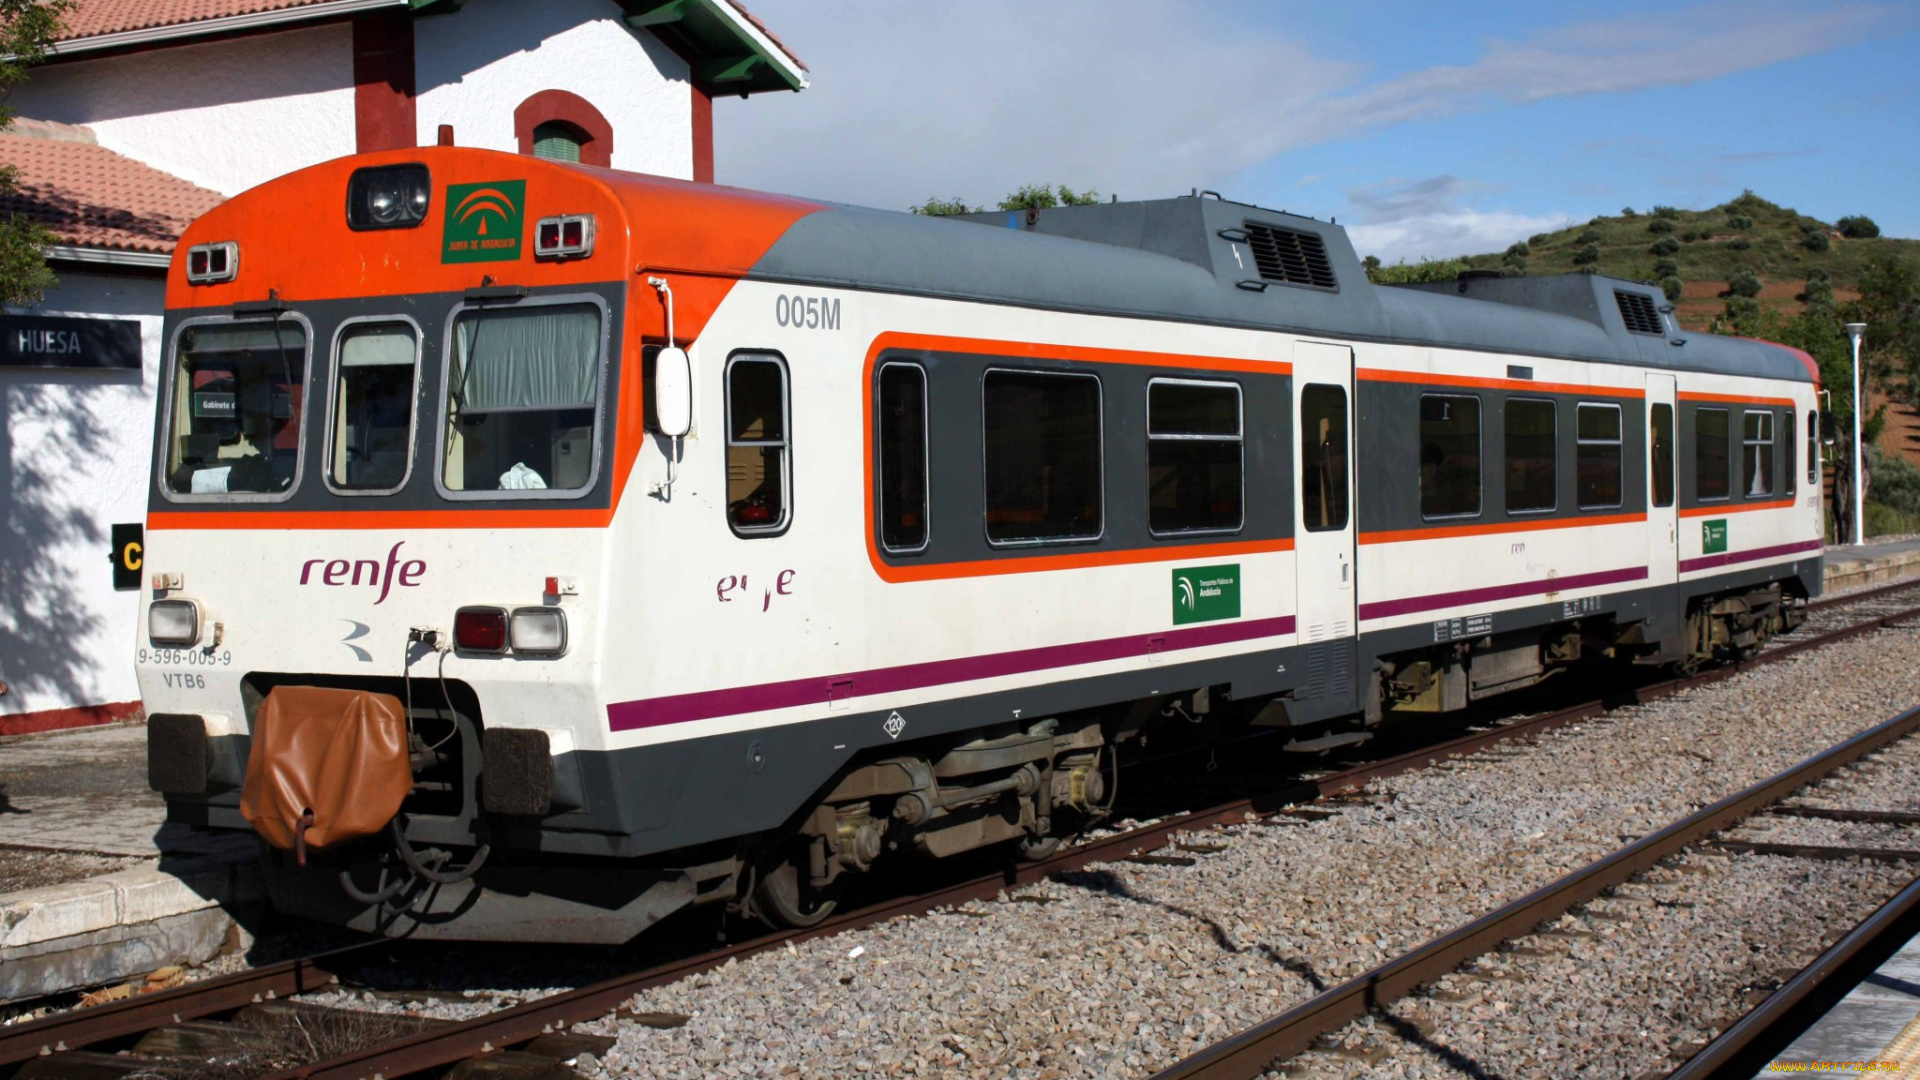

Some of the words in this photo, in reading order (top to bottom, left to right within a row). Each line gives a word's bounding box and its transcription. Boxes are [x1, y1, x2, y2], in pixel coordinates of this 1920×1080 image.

[448, 241, 468, 251] JUNTA
[471, 240, 479, 250] DE
[776, 294, 841, 330] 005M
[19, 329, 81, 354] HUESA
[202, 401, 230, 410] Gabinete
[124, 542, 142, 571] C
[299, 540, 427, 606] renfe
[139, 648, 231, 666] 9-596-005-9
[163, 673, 205, 689] VTB6
[888, 717, 903, 732] 120
